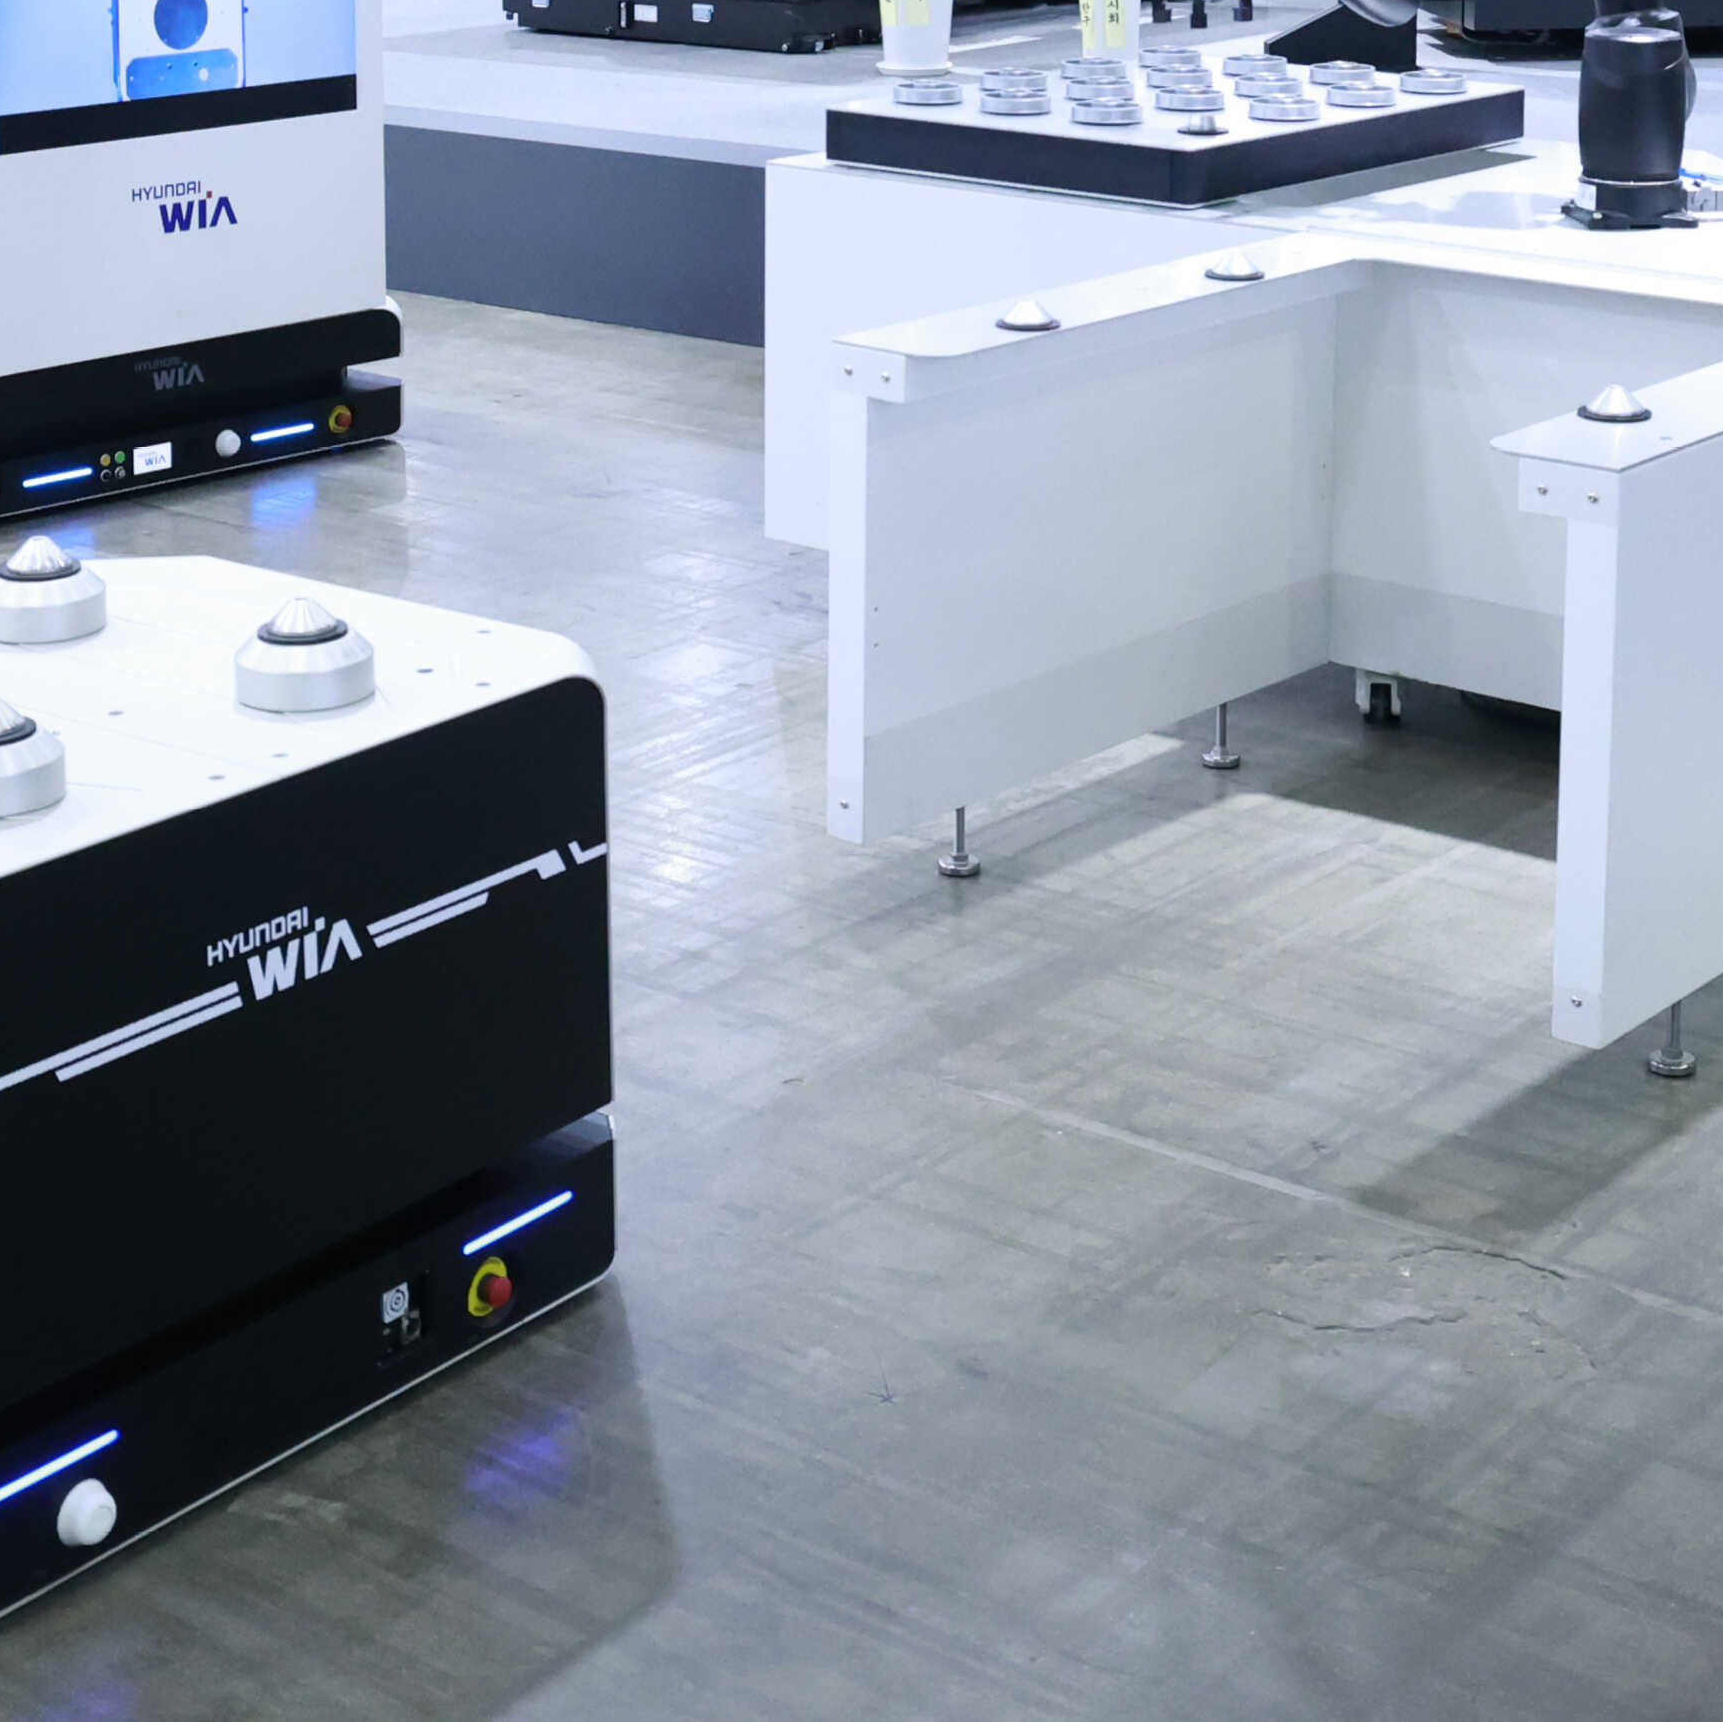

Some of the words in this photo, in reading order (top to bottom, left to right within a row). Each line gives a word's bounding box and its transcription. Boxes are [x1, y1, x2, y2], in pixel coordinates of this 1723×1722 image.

[131, 180, 202, 204] HYUNDAI
[159, 189, 238, 234] WIA
[152, 362, 205, 391] WIA
[206, 905, 309, 968] HYUNDAI
[246, 916, 363, 1001] WIA
